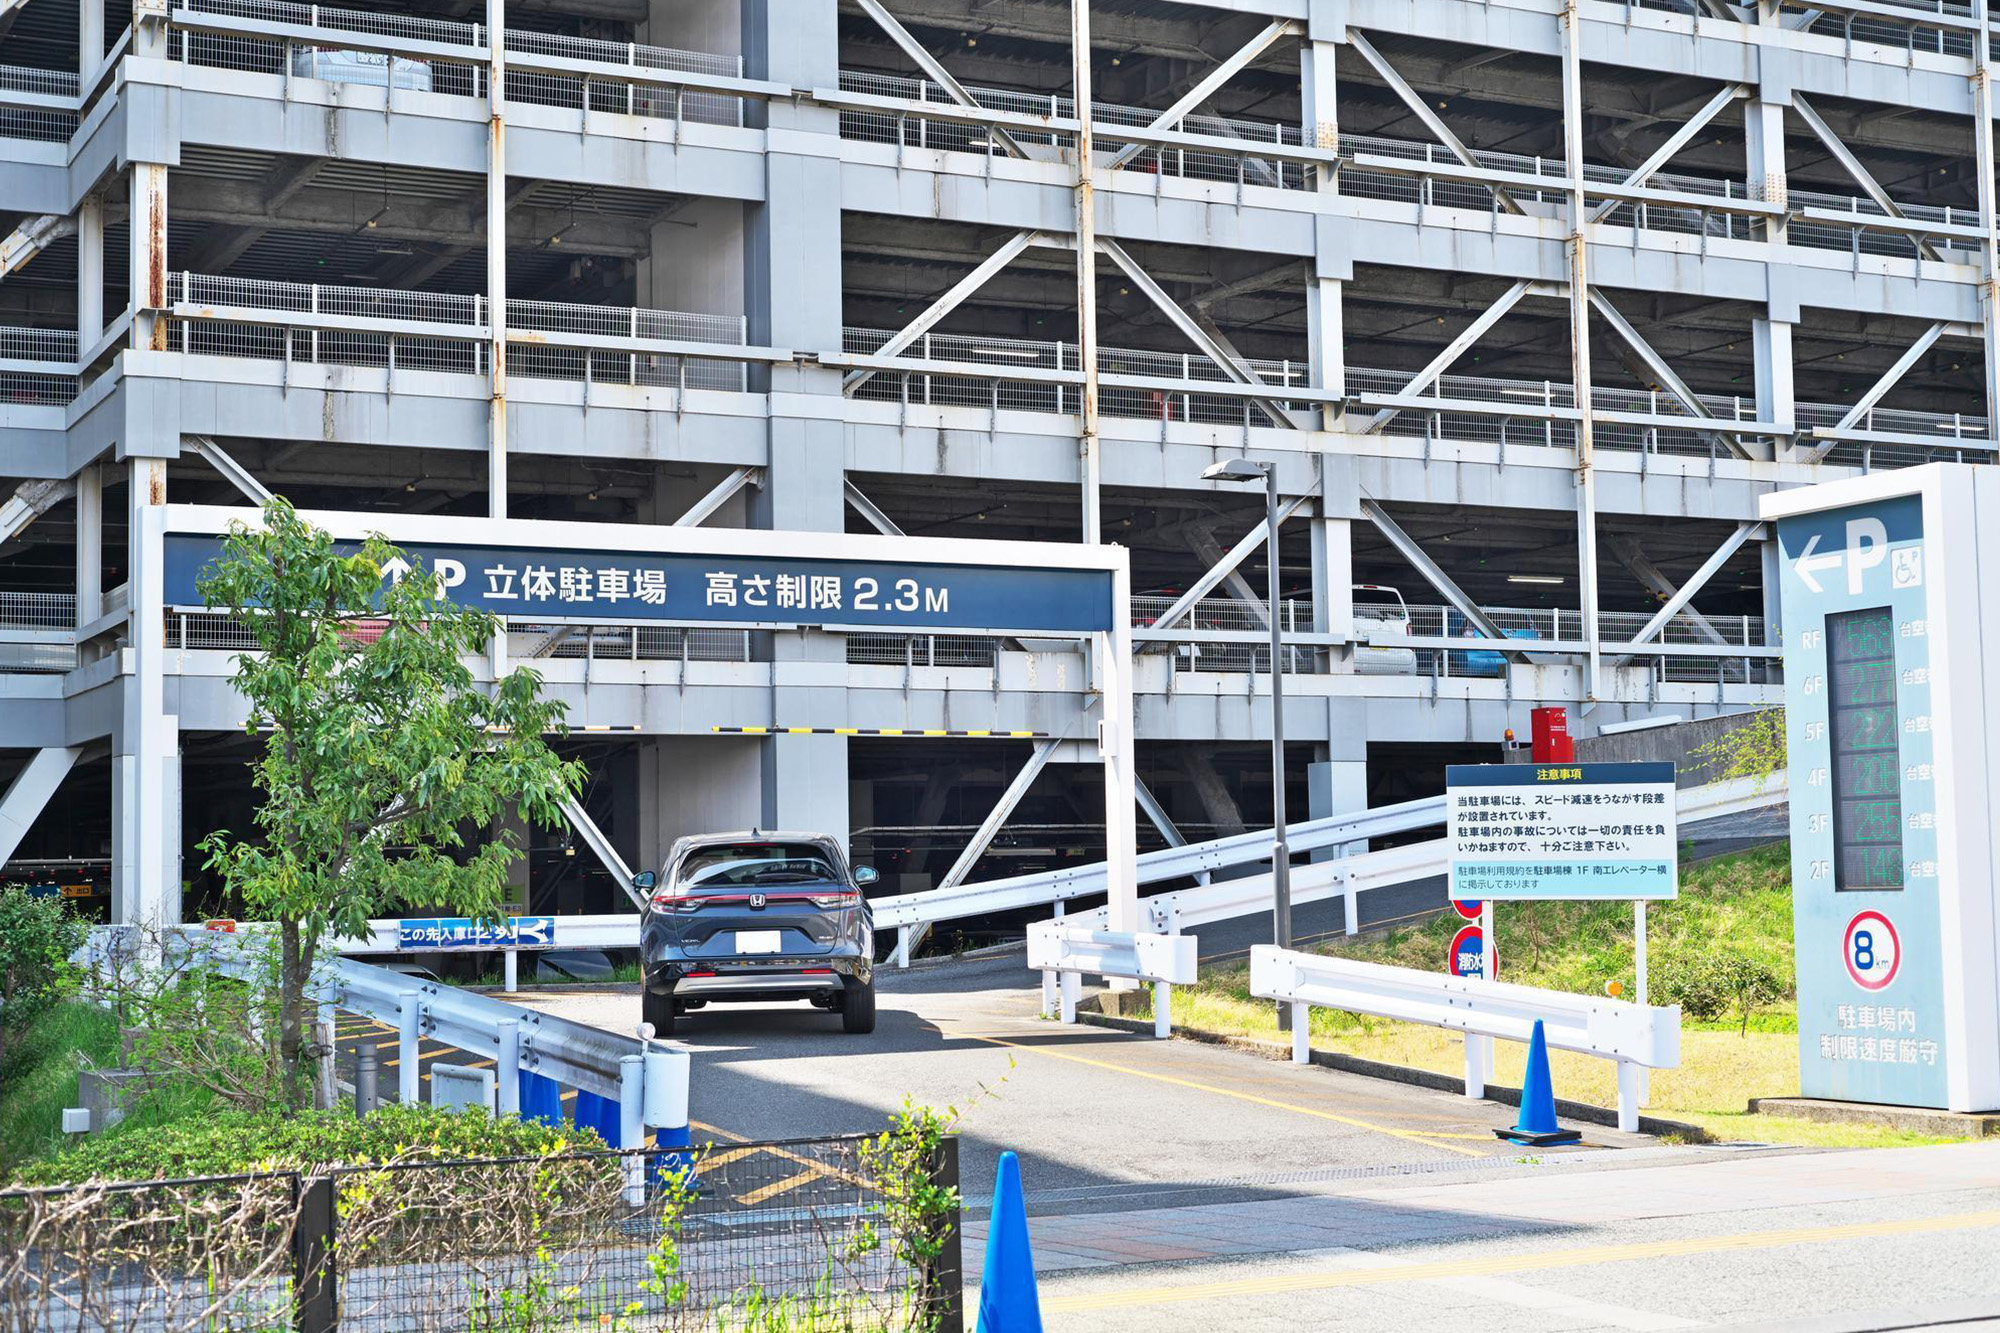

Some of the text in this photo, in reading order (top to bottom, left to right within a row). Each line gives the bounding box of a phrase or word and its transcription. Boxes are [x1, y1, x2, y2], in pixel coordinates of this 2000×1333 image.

[1846, 517, 1888, 595] P
[434, 558, 949, 614] P 立体駐車場 高さ制限 2.3M
[1802, 630, 1821, 649] RF
[1804, 676, 1822, 695] 6F
[1805, 722, 1824, 741] 5F
[1537, 768, 1582, 780] 注意事項
[1807, 768, 1827, 787] 4F
[1457, 792, 1665, 807] 当駐車場には、スピード減速をうながす段差
[1457, 811, 1552, 822] が設置されています。
[1808, 814, 1828, 833] 3F
[1457, 824, 1665, 837] 駐車場内の事故については一切の責任を負
[1457, 840, 1631, 852] いかねますので、十分ご注意下さい。
[1458, 864, 1666, 876] 駐車場利用規約を駐車場棟 1F 南エレベーター横
[1810, 861, 1829, 880] 2F
[76, 887, 89, 895] 出口
[1458, 878, 1539, 890] に掲示しております
[1854, 930, 1890, 970] 8 km
[1838, 1005, 1916, 1032] 駐車場内
[1820, 1035, 1938, 1066] 制限速度厳守
